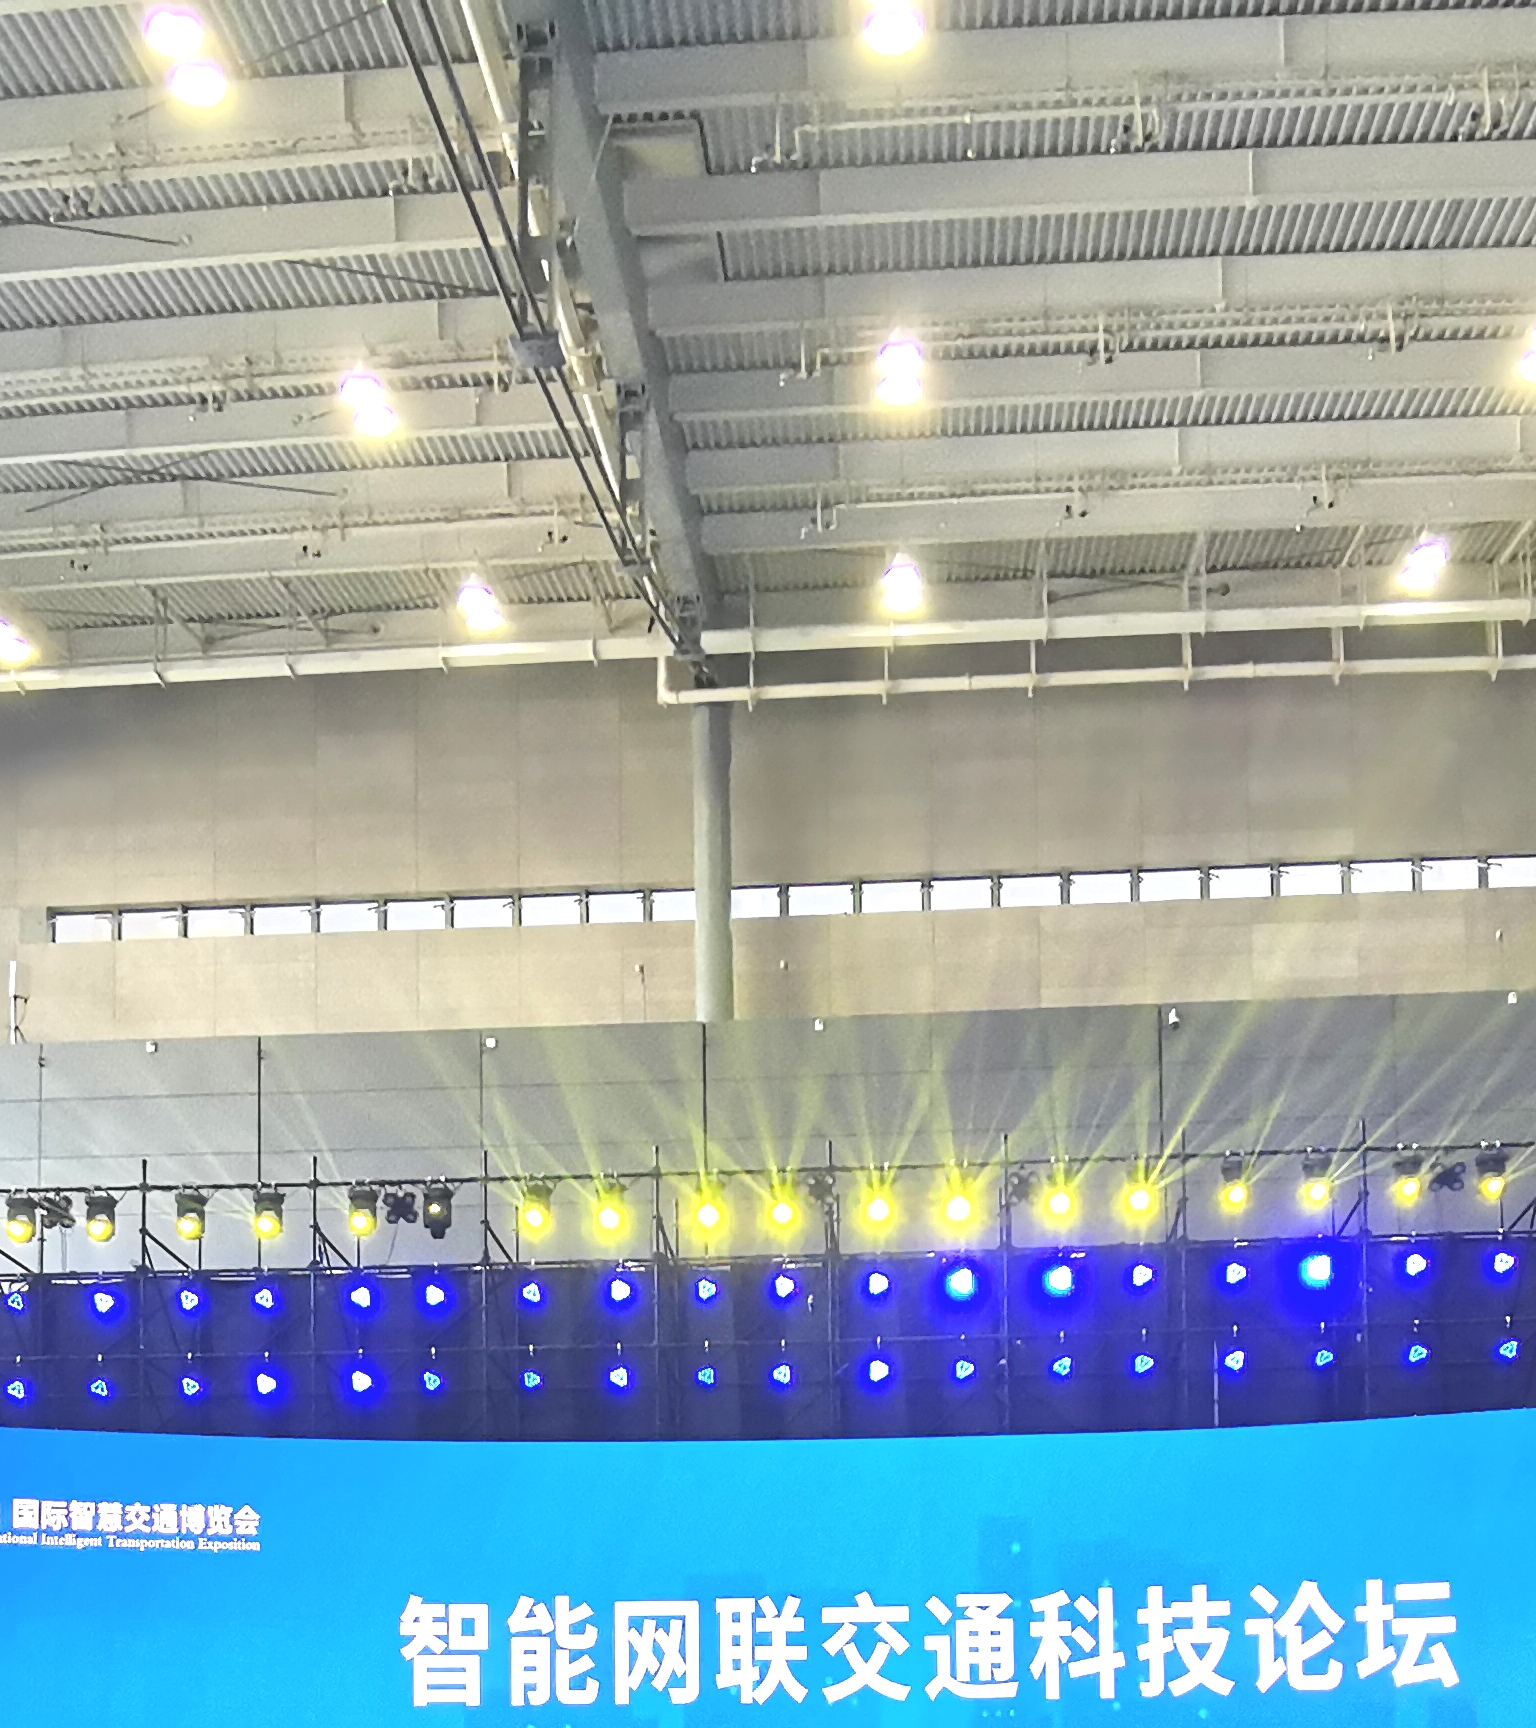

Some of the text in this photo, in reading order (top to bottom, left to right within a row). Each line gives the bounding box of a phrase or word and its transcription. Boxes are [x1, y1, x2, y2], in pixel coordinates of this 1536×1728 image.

[41, 1532, 102, 1549] Intelligent
[106, 1535, 196, 1552] Transportation
[198, 1537, 261, 1553] Exposition
[399, 1578, 1461, 1707] 智能网联交通科技论坛
